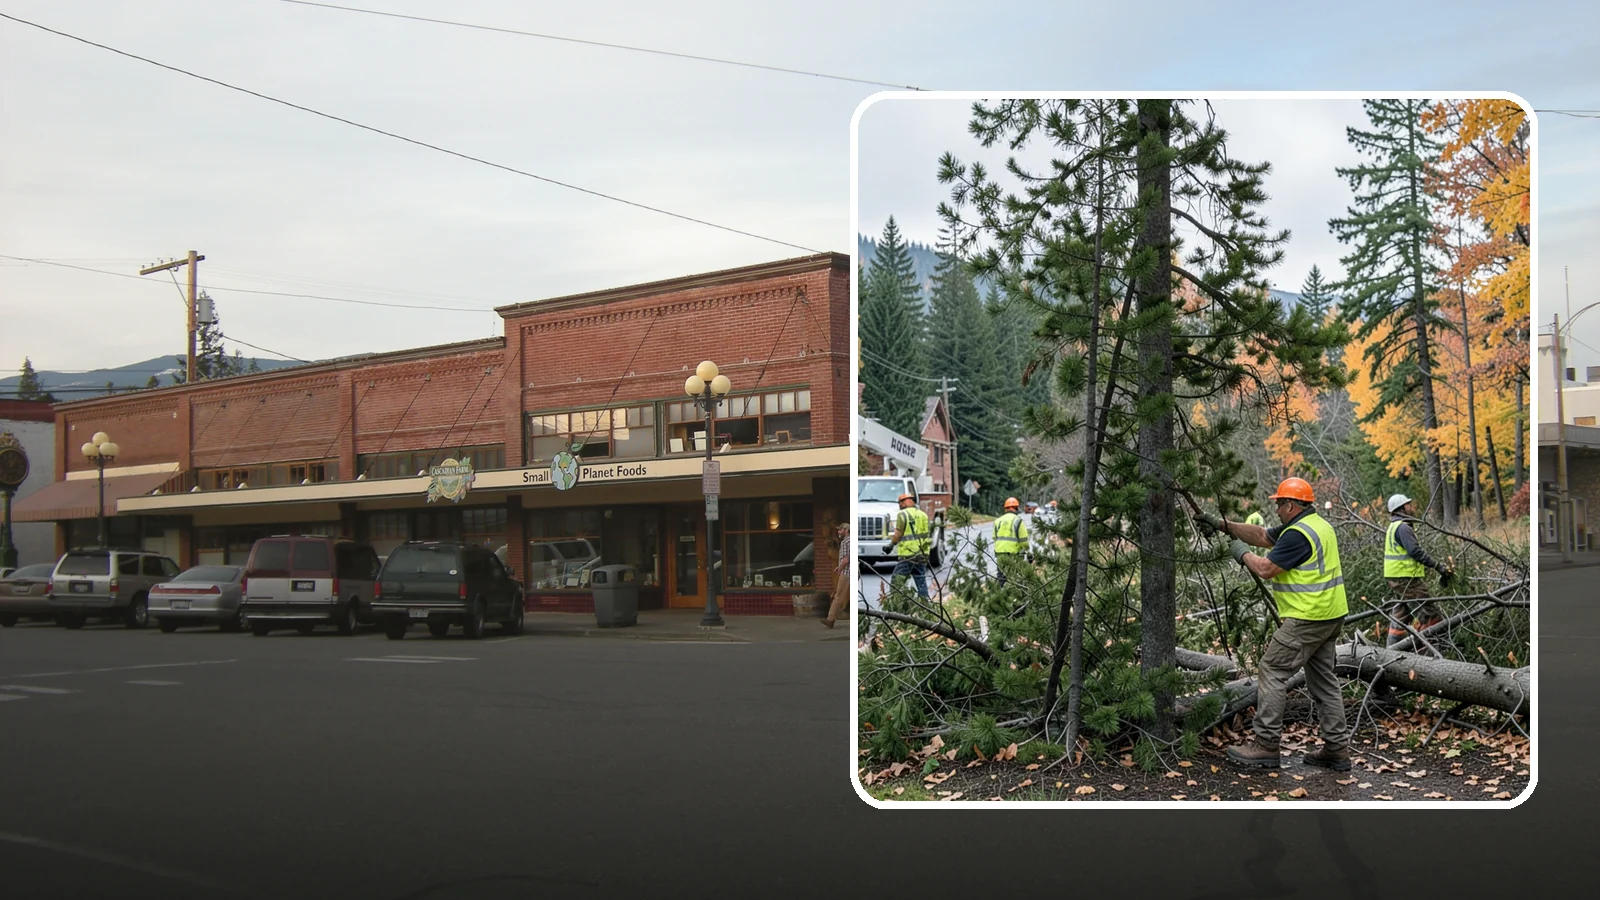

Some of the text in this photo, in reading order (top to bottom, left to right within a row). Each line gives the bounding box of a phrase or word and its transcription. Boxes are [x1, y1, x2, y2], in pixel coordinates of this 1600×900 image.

[523, 464, 647, 483] Small Planet Foods
